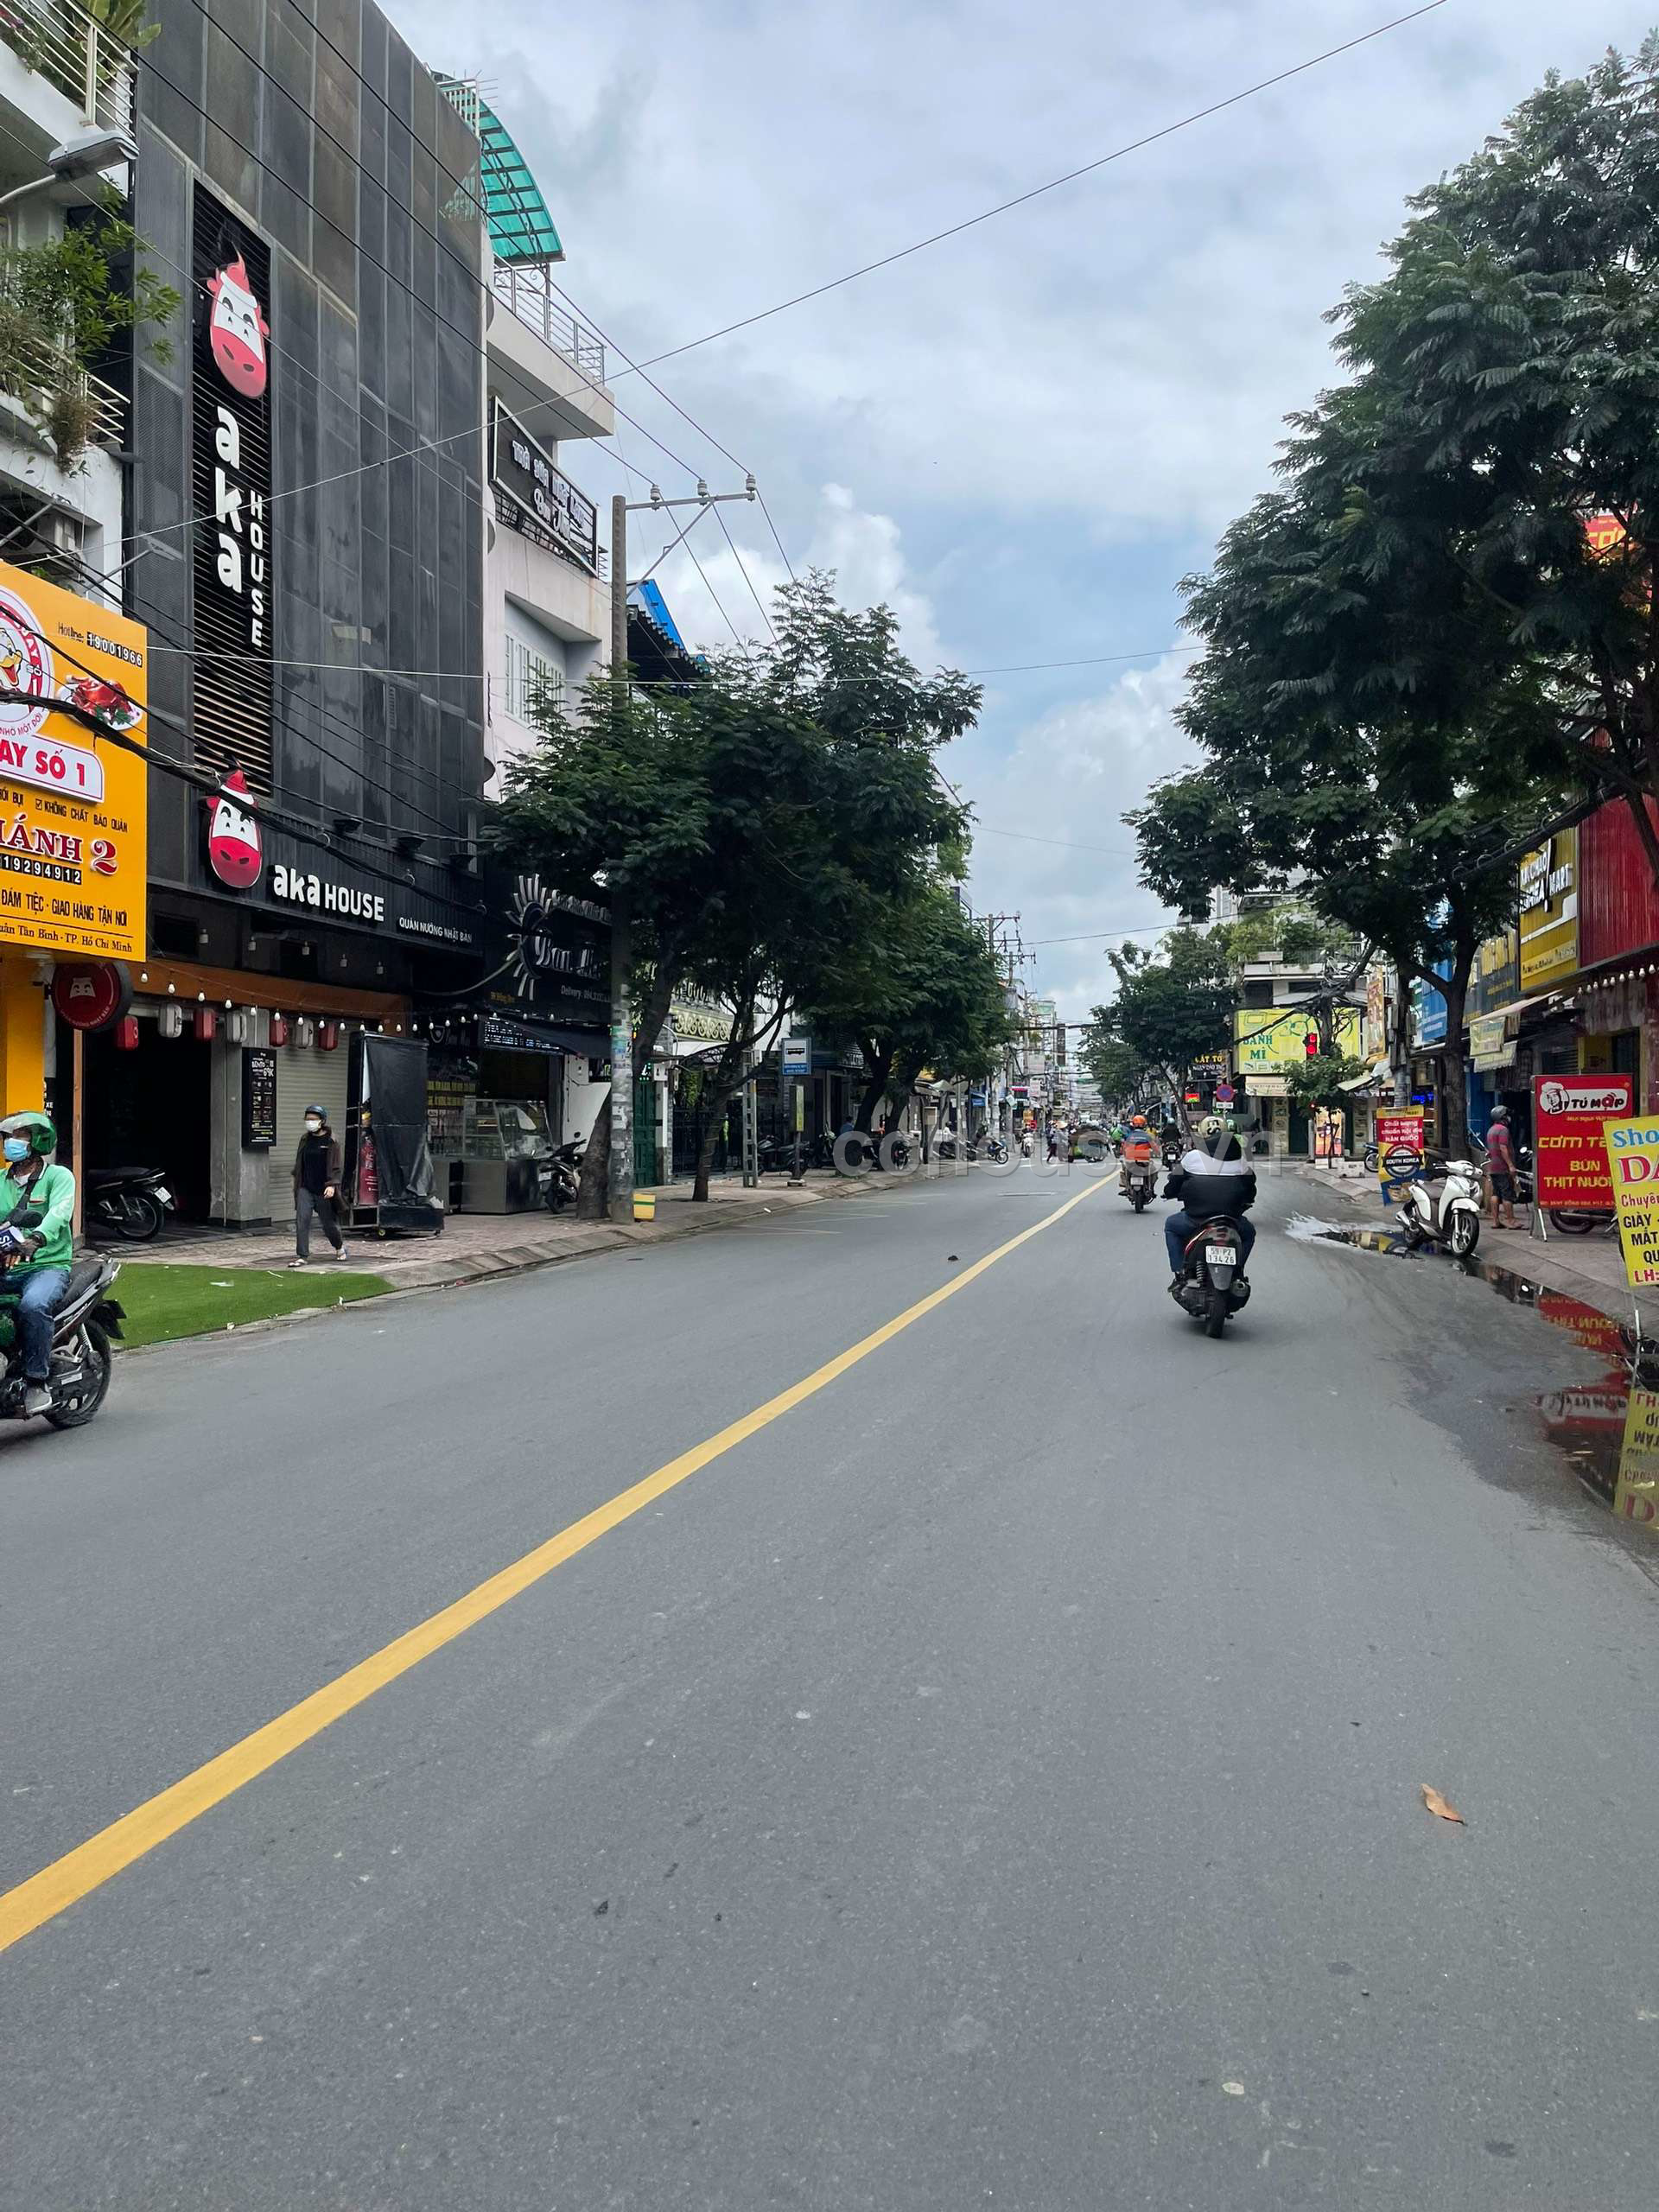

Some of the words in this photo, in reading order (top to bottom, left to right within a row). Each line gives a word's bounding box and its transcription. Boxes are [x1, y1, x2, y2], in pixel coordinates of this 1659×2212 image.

[87, 632, 143, 668] 19001966
[35, 750, 66, 779] SỐ
[77, 763, 85, 786] 1
[92, 840, 118, 875] 2
[26, 891, 44, 916] TIỆC
[52, 898, 71, 917] GIAO
[73, 901, 94, 922] HÀNG
[98, 905, 113, 927] TẬN
[273, 864, 321, 906] aka
[325, 883, 385, 922] HOUSE
[18, 925, 35, 938] Tân
[39, 928, 59, 942] Bình
[81, 935, 93, 947] Hồ
[95, 937, 109, 949] Chí
[111, 940, 132, 952] Minh
[1621, 1192, 1659, 1209] Chuyê
[1624, 1211, 1651, 1228] GIÀY
